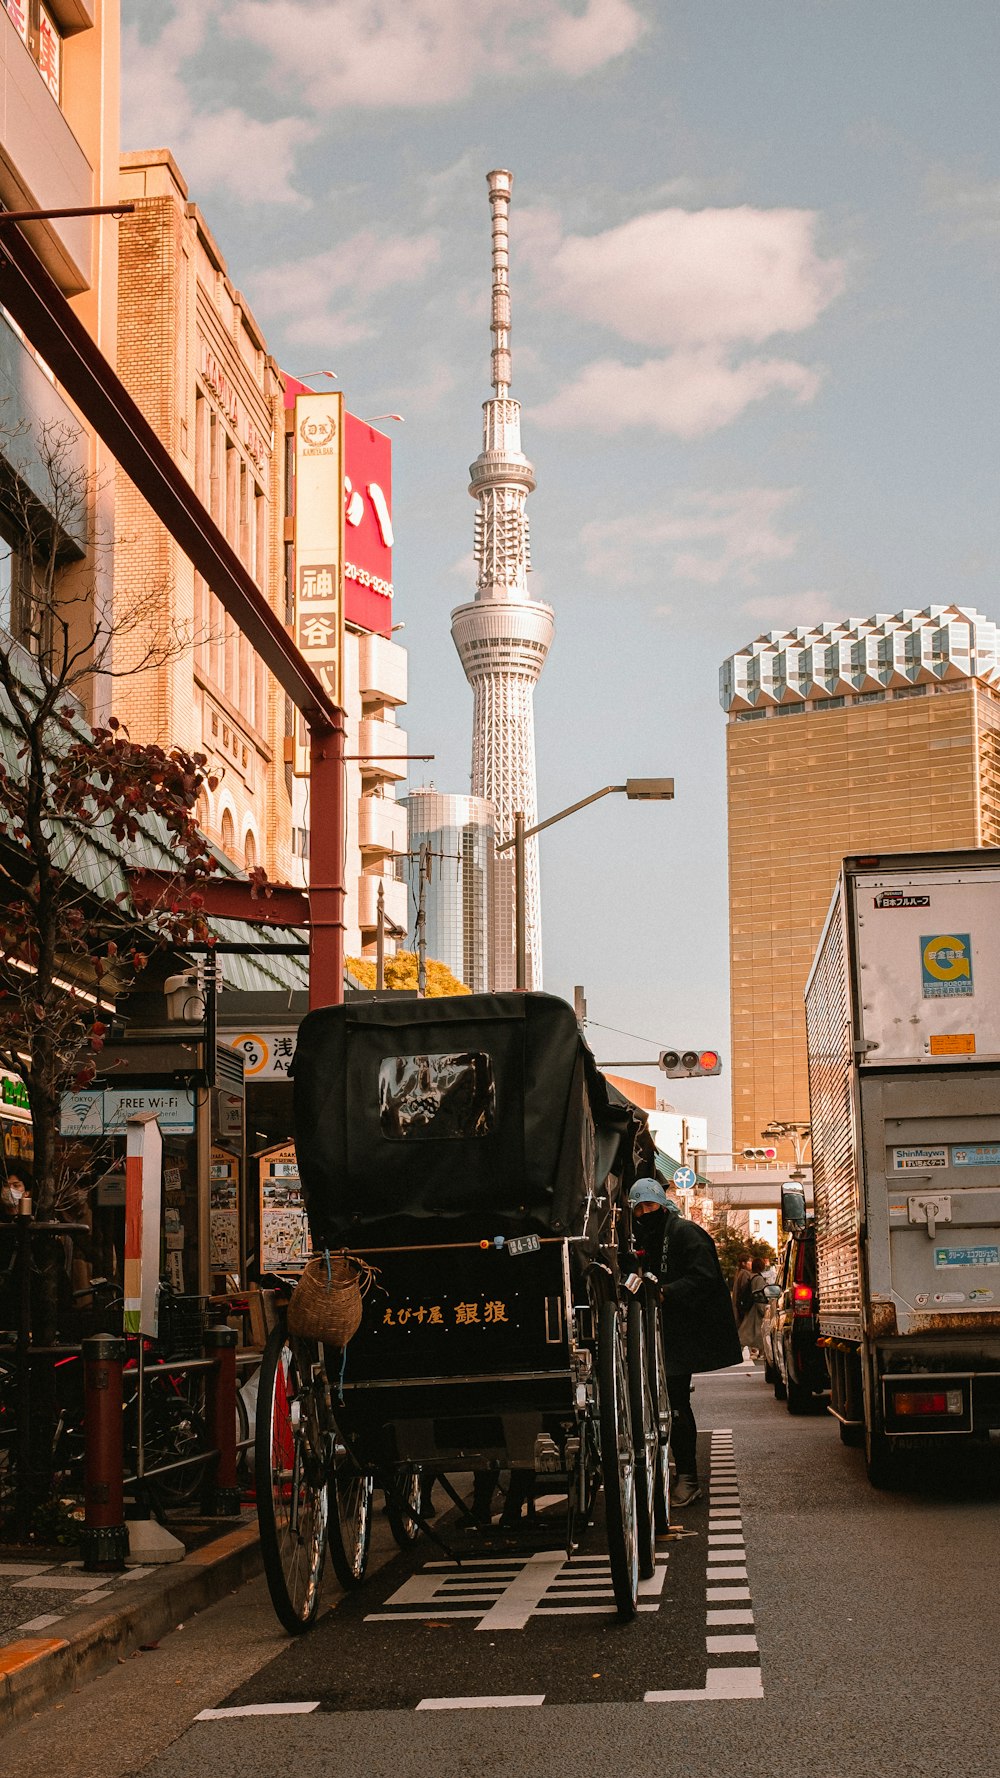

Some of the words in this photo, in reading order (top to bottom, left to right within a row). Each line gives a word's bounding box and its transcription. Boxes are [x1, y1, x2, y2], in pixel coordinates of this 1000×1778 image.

[302, 448, 321, 457] KAMIYA
[322, 447, 334, 456] BAR
[883, 897, 929, 907] 日本フルハーフ
[244, 1041, 254, 1053] G
[249, 1054, 258, 1066] 9
[120, 1098, 145, 1108] FREE
[149, 1097, 178, 1108] Wi-Fi
[896, 1150, 945, 1158] ShinMaywa
[383, 1305, 444, 1325] えびす屋
[454, 1301, 509, 1325] 銀狼
